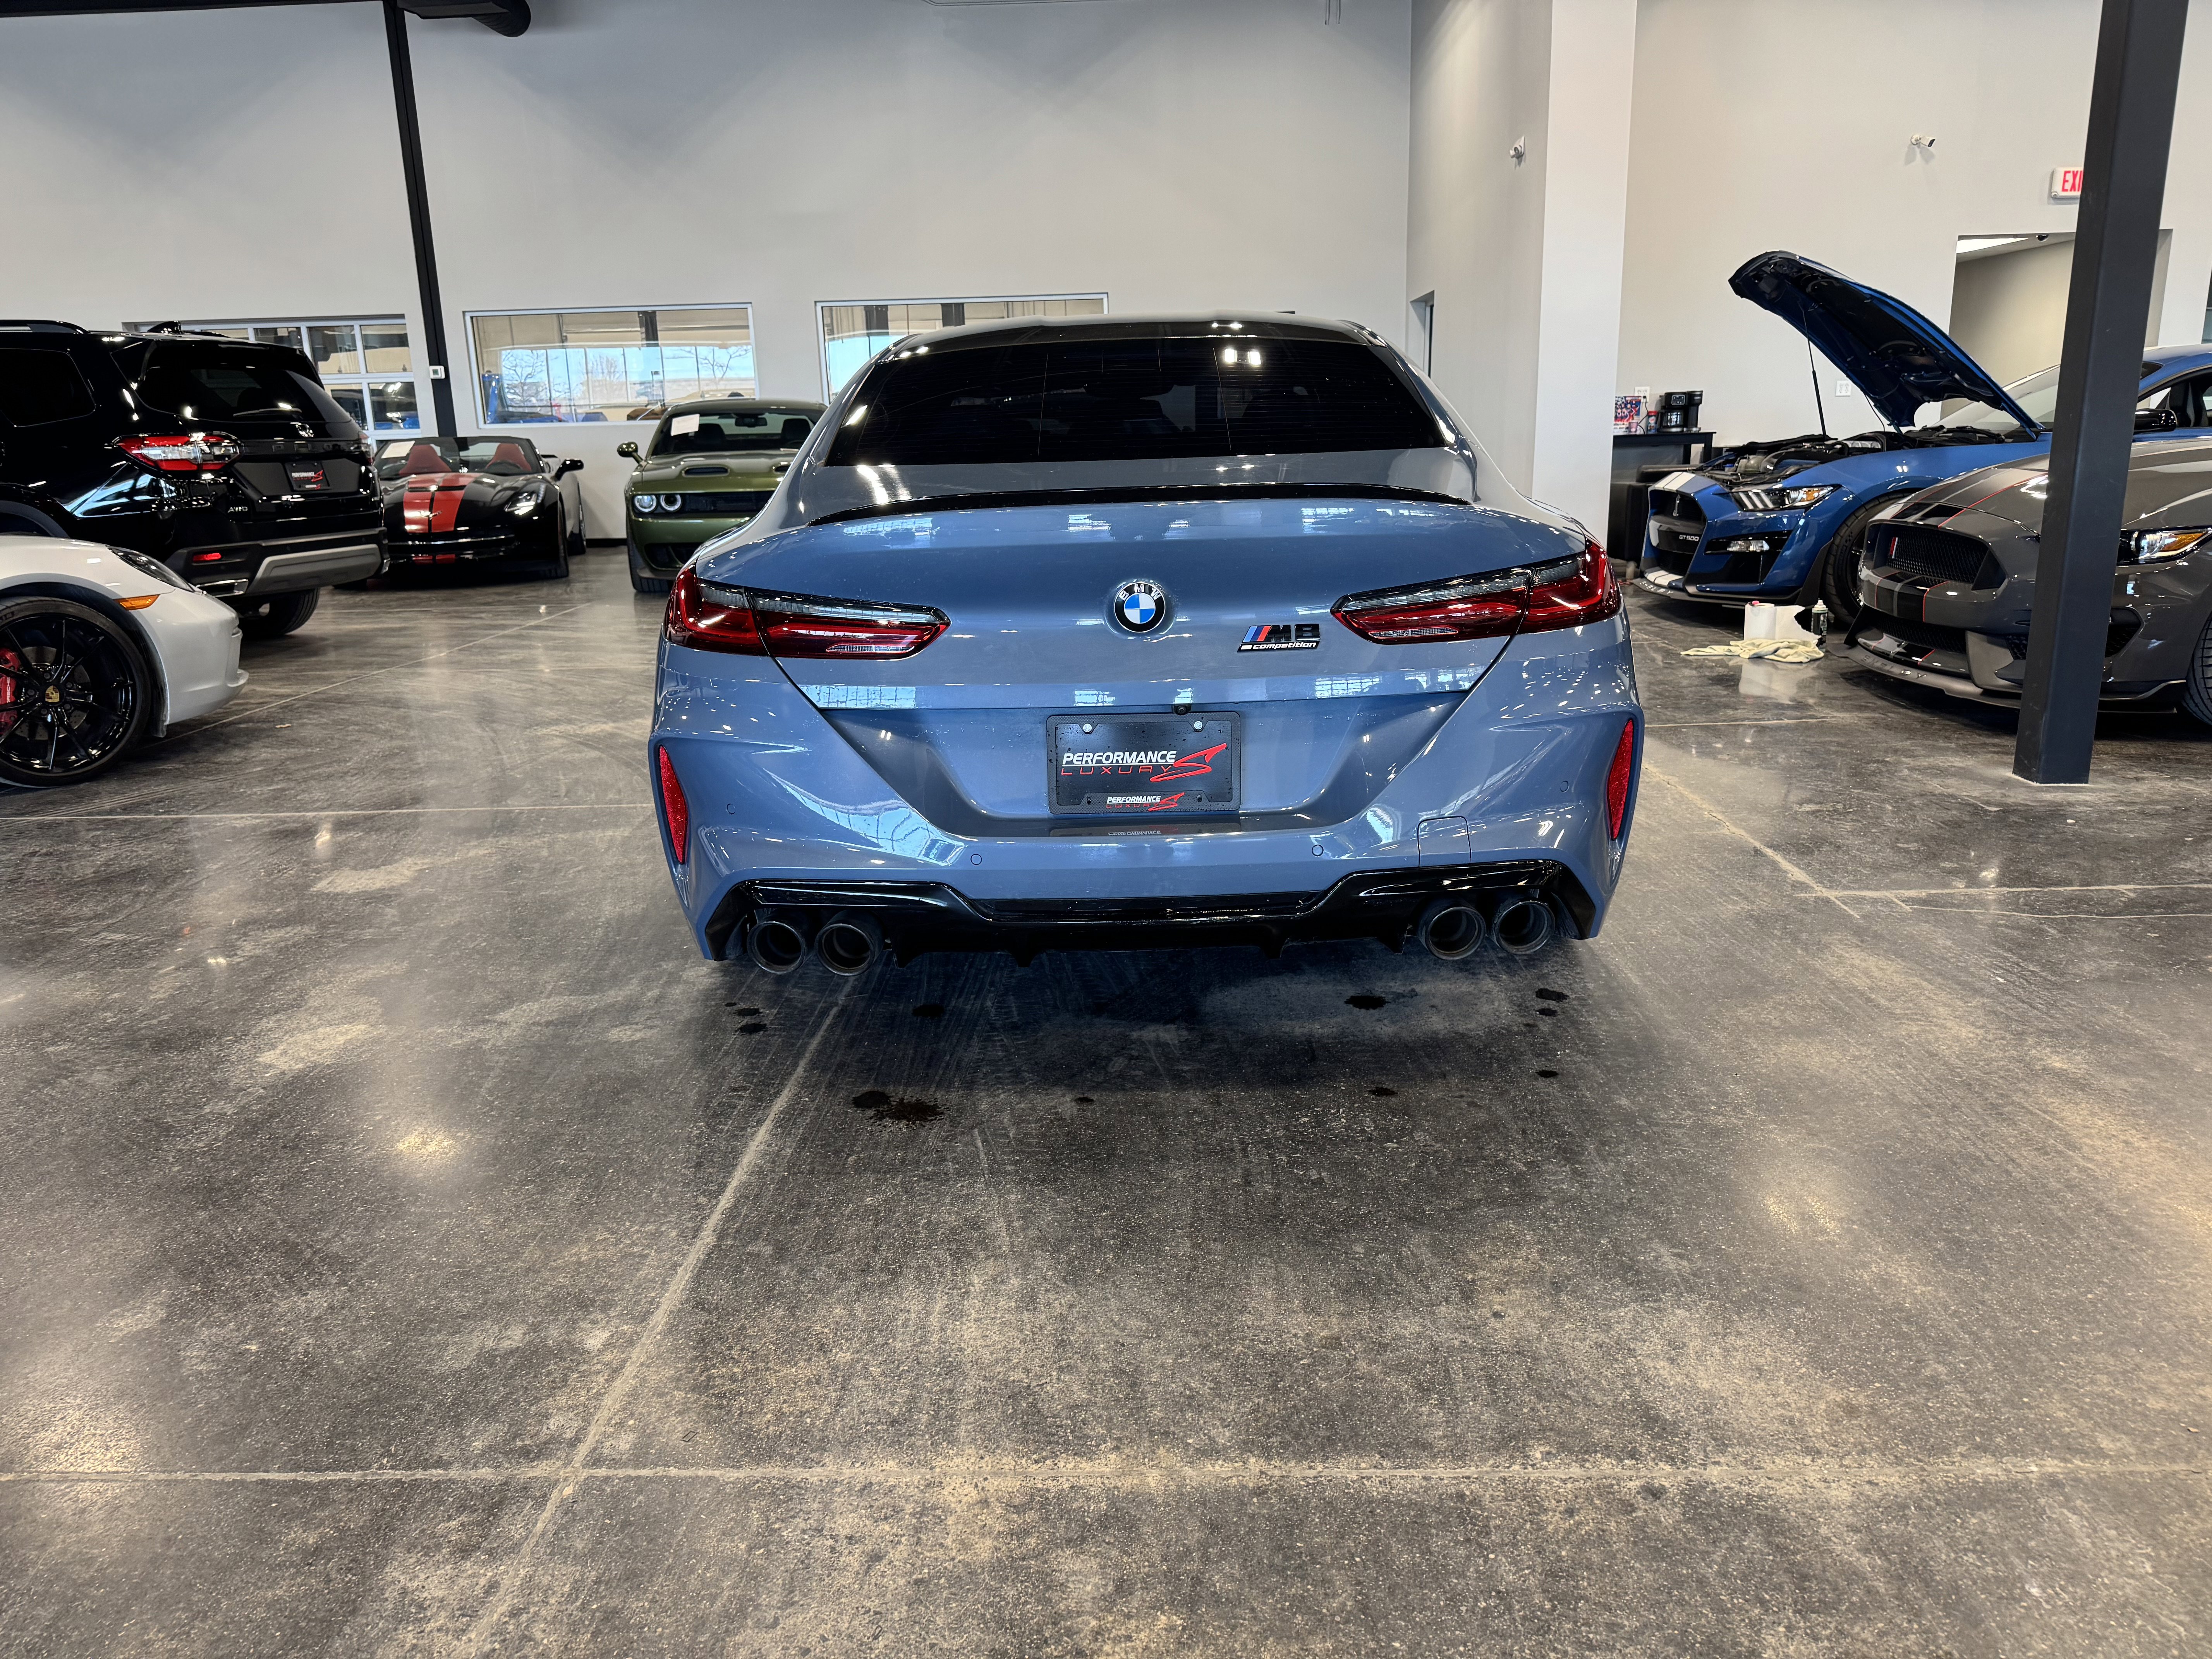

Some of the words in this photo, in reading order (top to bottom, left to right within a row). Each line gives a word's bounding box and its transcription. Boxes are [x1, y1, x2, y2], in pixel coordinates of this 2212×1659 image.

[2062, 170, 2083, 192] EXI
[1118, 584, 1161, 601] BMW
[1263, 623, 1320, 641] M8
[1062, 750, 1177, 764] PERFORMANCE
[1061, 765, 1172, 776] LUXURY
